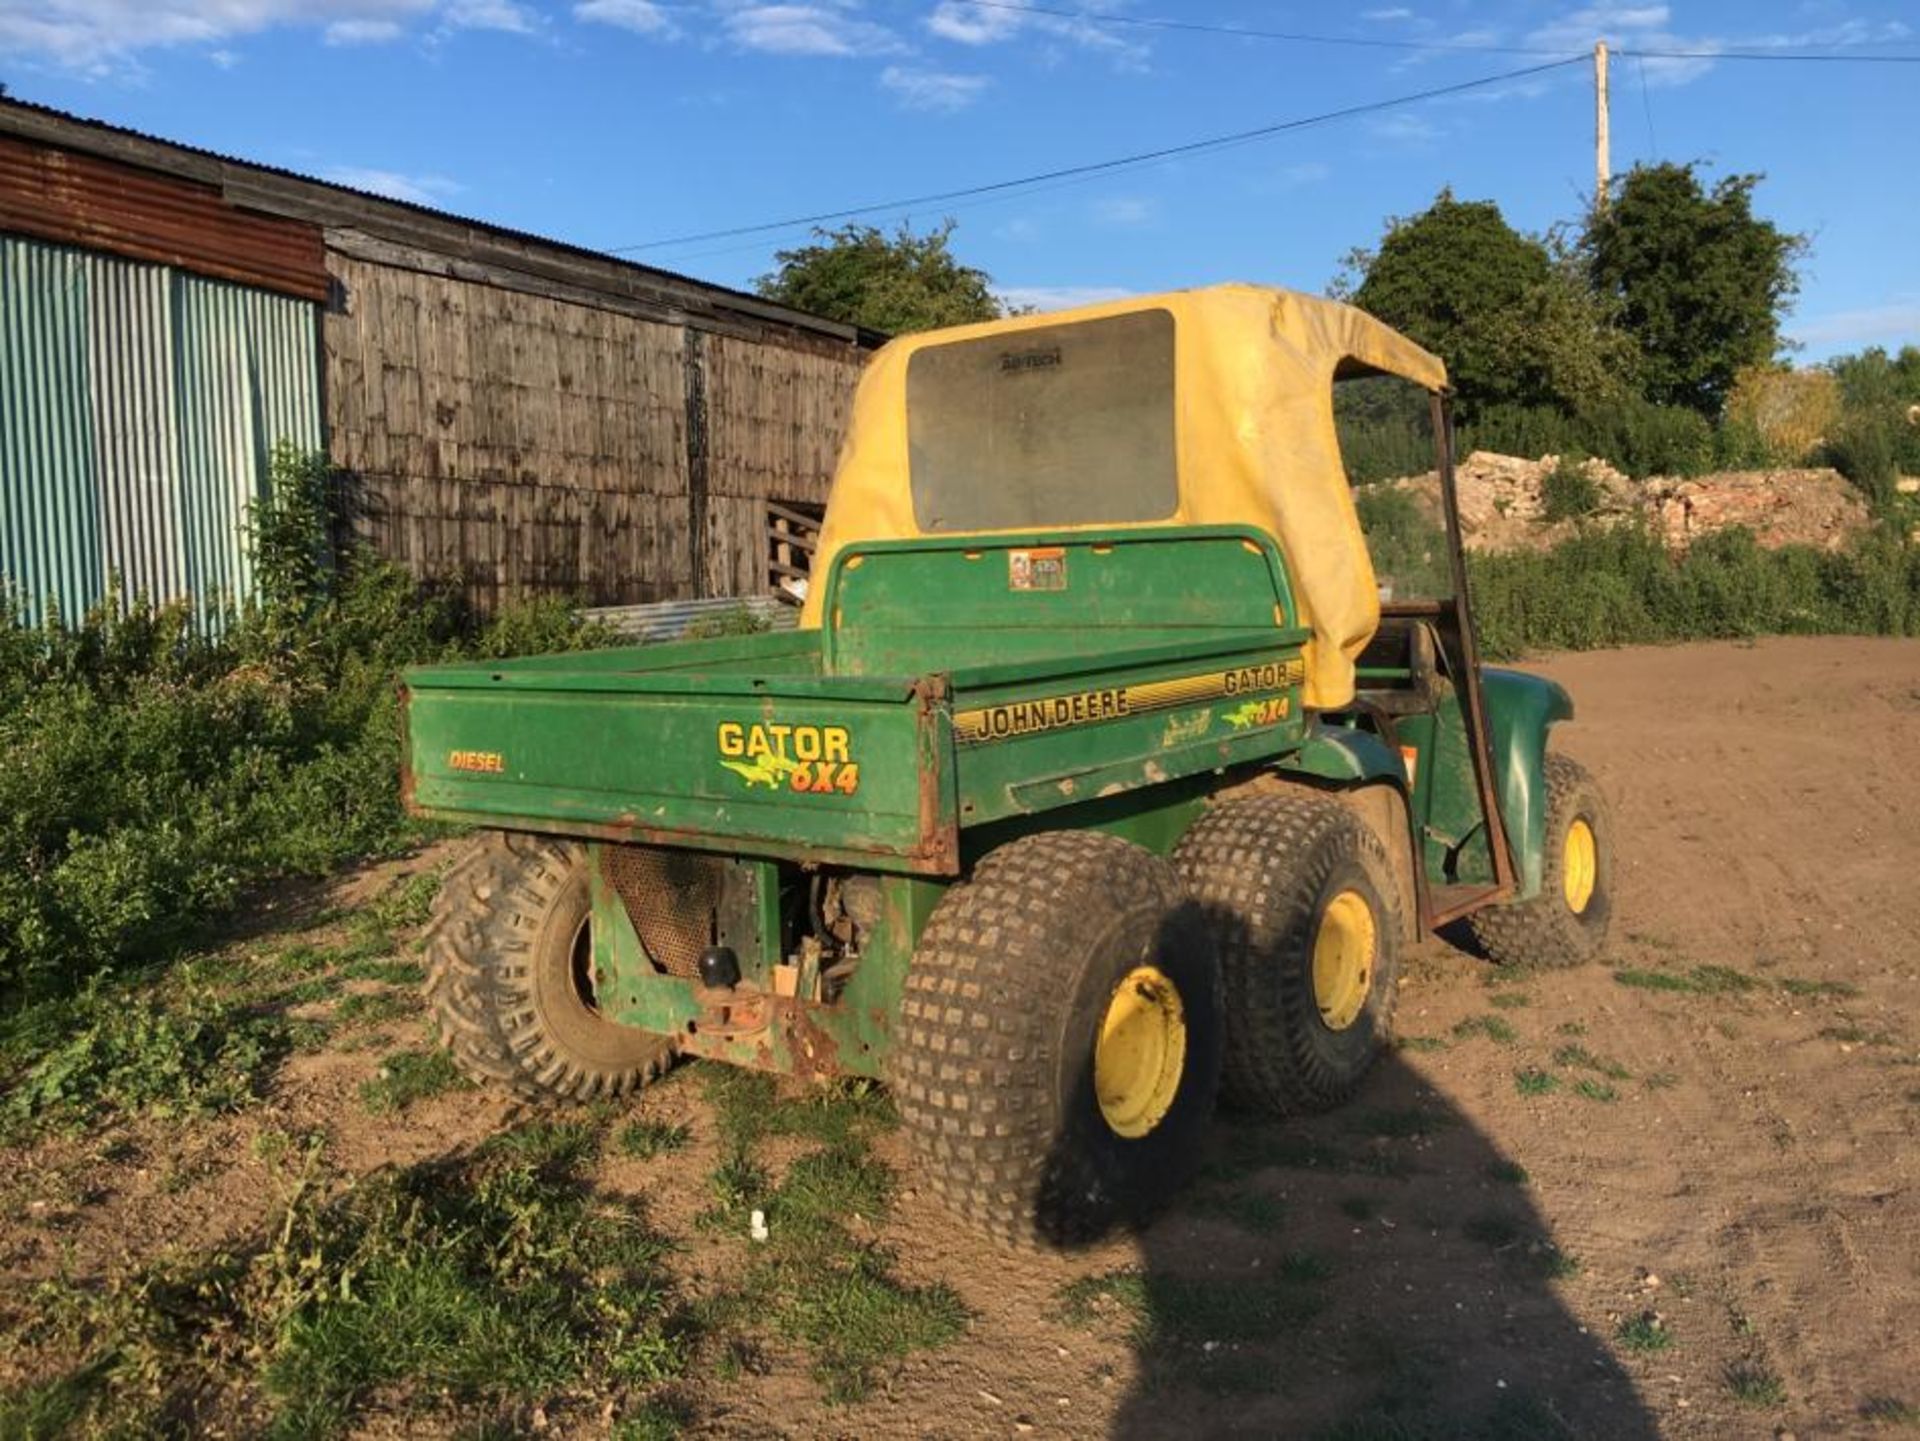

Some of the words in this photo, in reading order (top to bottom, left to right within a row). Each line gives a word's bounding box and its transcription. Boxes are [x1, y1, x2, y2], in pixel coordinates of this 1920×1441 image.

[1224, 663, 1287, 694] GATOR
[976, 702, 1047, 739] JOHN
[1053, 689, 1128, 724] DEERE
[718, 721, 851, 763] GATOR
[449, 750, 505, 772] DIESEL
[790, 760, 859, 795] 6X4
